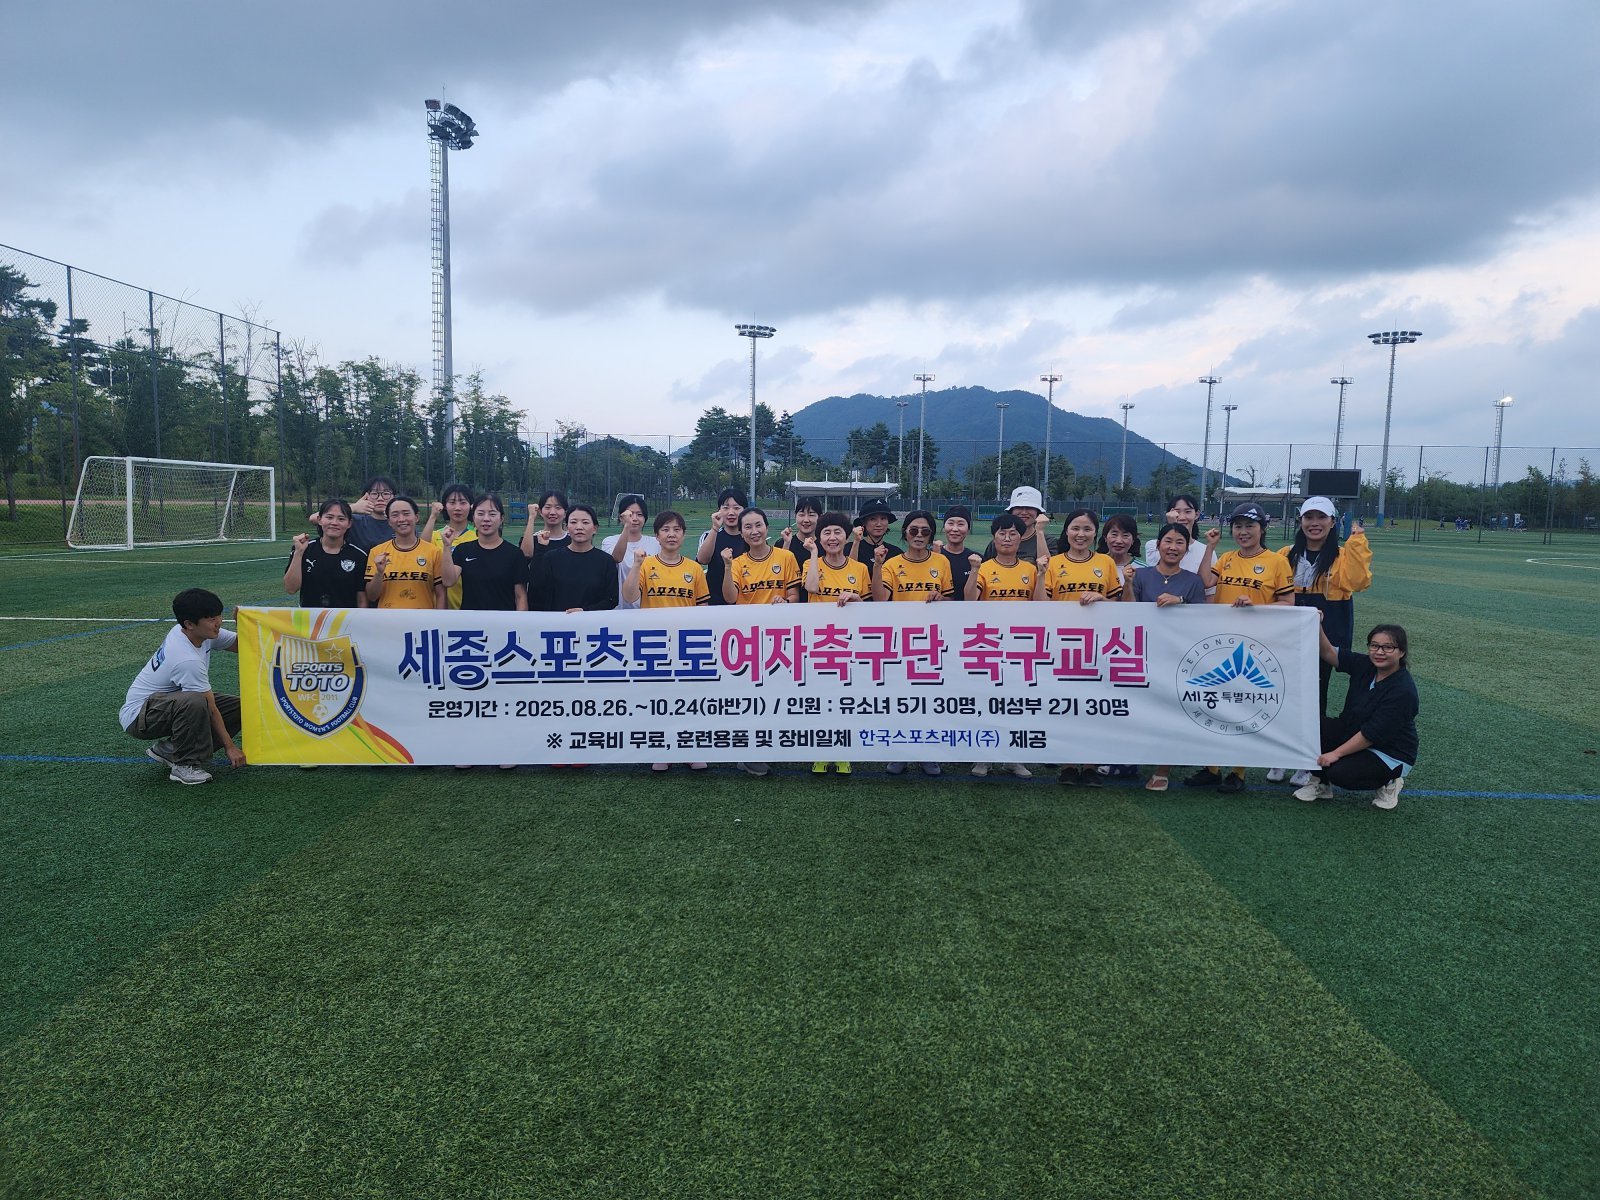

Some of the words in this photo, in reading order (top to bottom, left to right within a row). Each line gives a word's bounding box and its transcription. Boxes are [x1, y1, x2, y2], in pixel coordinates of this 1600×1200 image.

[647, 586, 694, 599] 스포츠토토
[741, 579, 785, 593] 스포츠토토
[897, 582, 941, 593] 스포츠토토
[1058, 582, 1105, 594] 스포츠토토
[959, 622, 1151, 688] 축구교실
[1181, 637, 1235, 674] SEJONG
[1249, 643, 1278, 674] CITY
[292, 662, 344, 673] SPORTS
[286, 673, 350, 692] TOTO
[298, 693, 318, 701] WFC
[321, 693, 339, 701] 2011
[428, 700, 498, 719] 운영기간
[787, 697, 821, 715] 인원
[839, 697, 890, 715] 유소녀
[897, 697, 927, 714] 5기
[933, 697, 982, 718] 30명,
[988, 697, 1042, 716] 여성부
[1048, 698, 1079, 716] 2기
[1085, 698, 1130, 717] 30명
[569, 731, 624, 750] 교육비
[629, 731, 671, 750] 무료,
[677, 730, 749, 749] 훈련용품
[755, 730, 774, 748] 및
[779, 729, 852, 748] 장비일체
[1009, 730, 1047, 749] 제공
